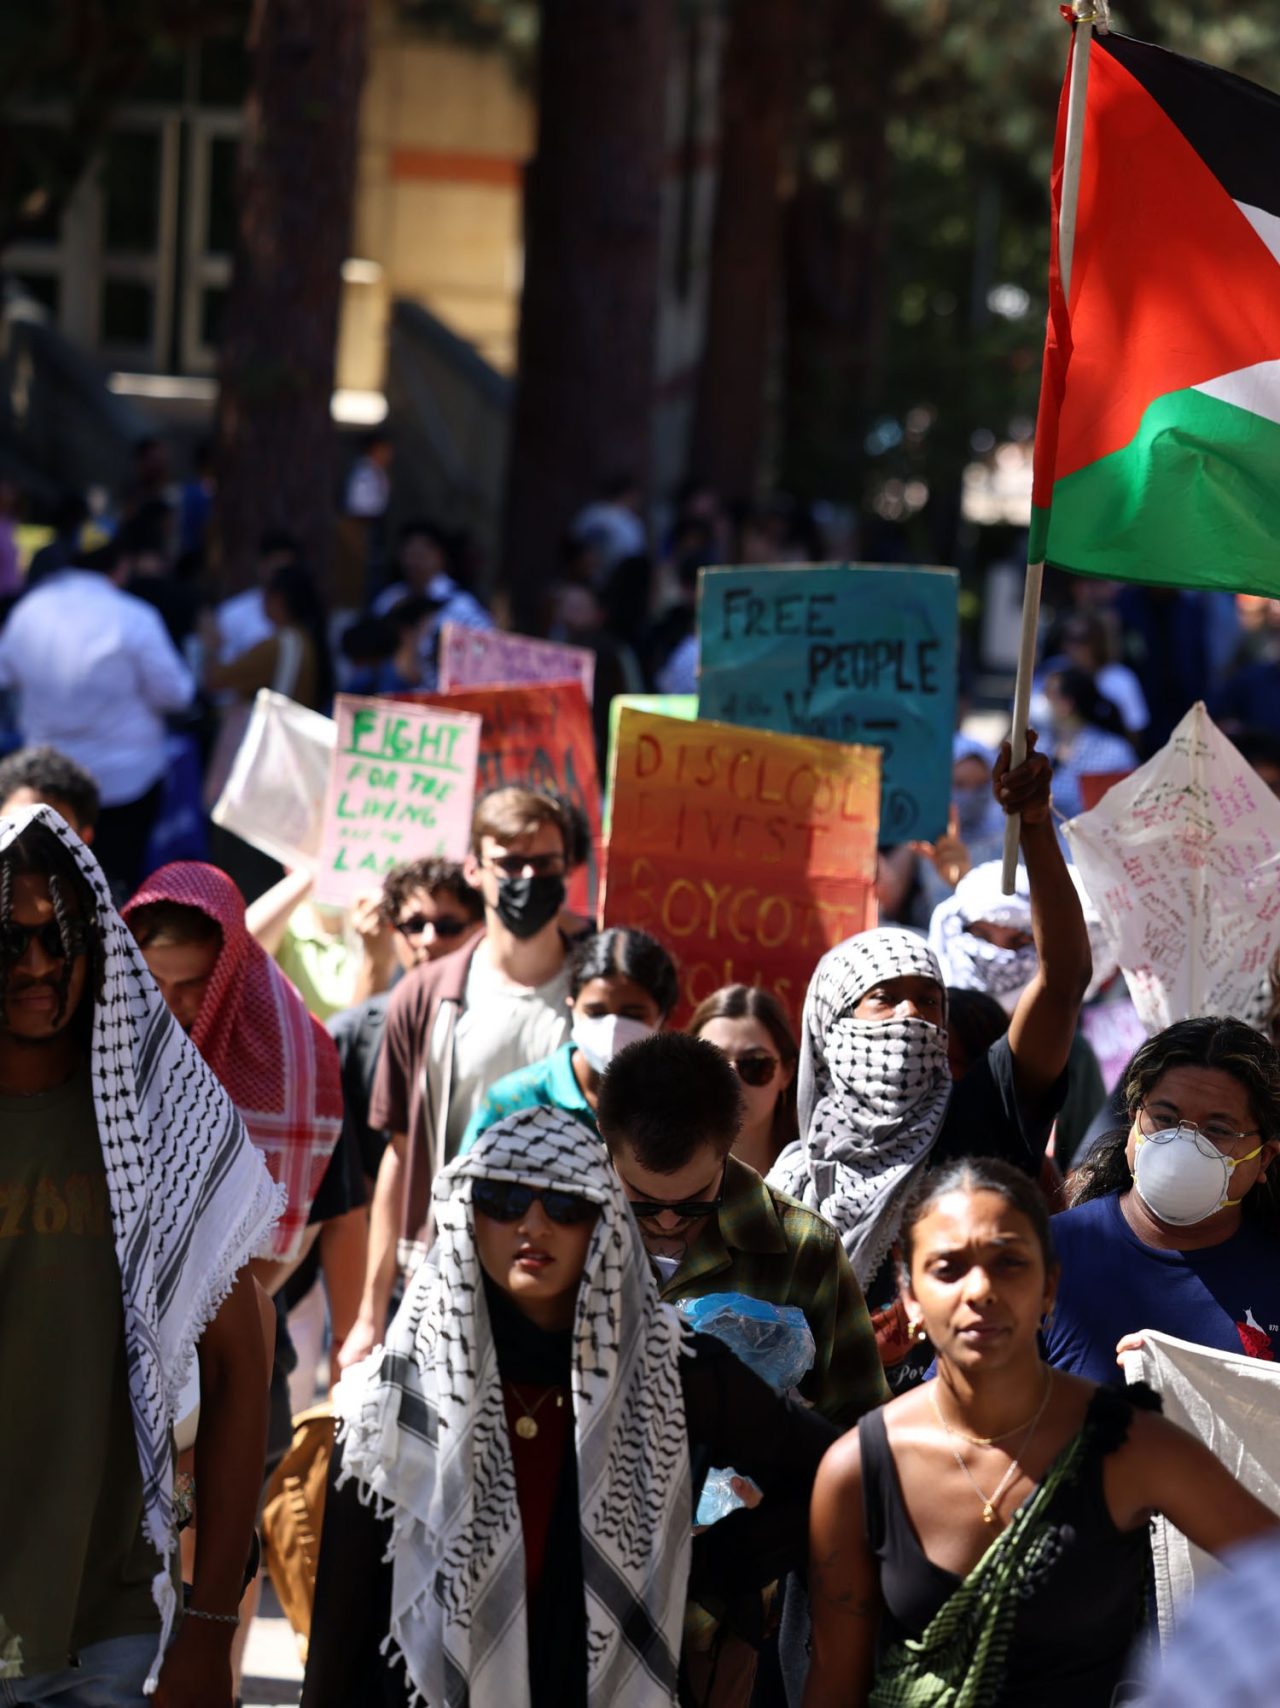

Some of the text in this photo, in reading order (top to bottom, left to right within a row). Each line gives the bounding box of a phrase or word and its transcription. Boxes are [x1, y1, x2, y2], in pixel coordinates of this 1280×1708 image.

[722, 587, 836, 641] FREE
[808, 638, 940, 694] PEOPLE
[352, 709, 467, 757] FIGHT
[347, 763, 399, 791] FOR
[336, 793, 437, 828] LIVING
